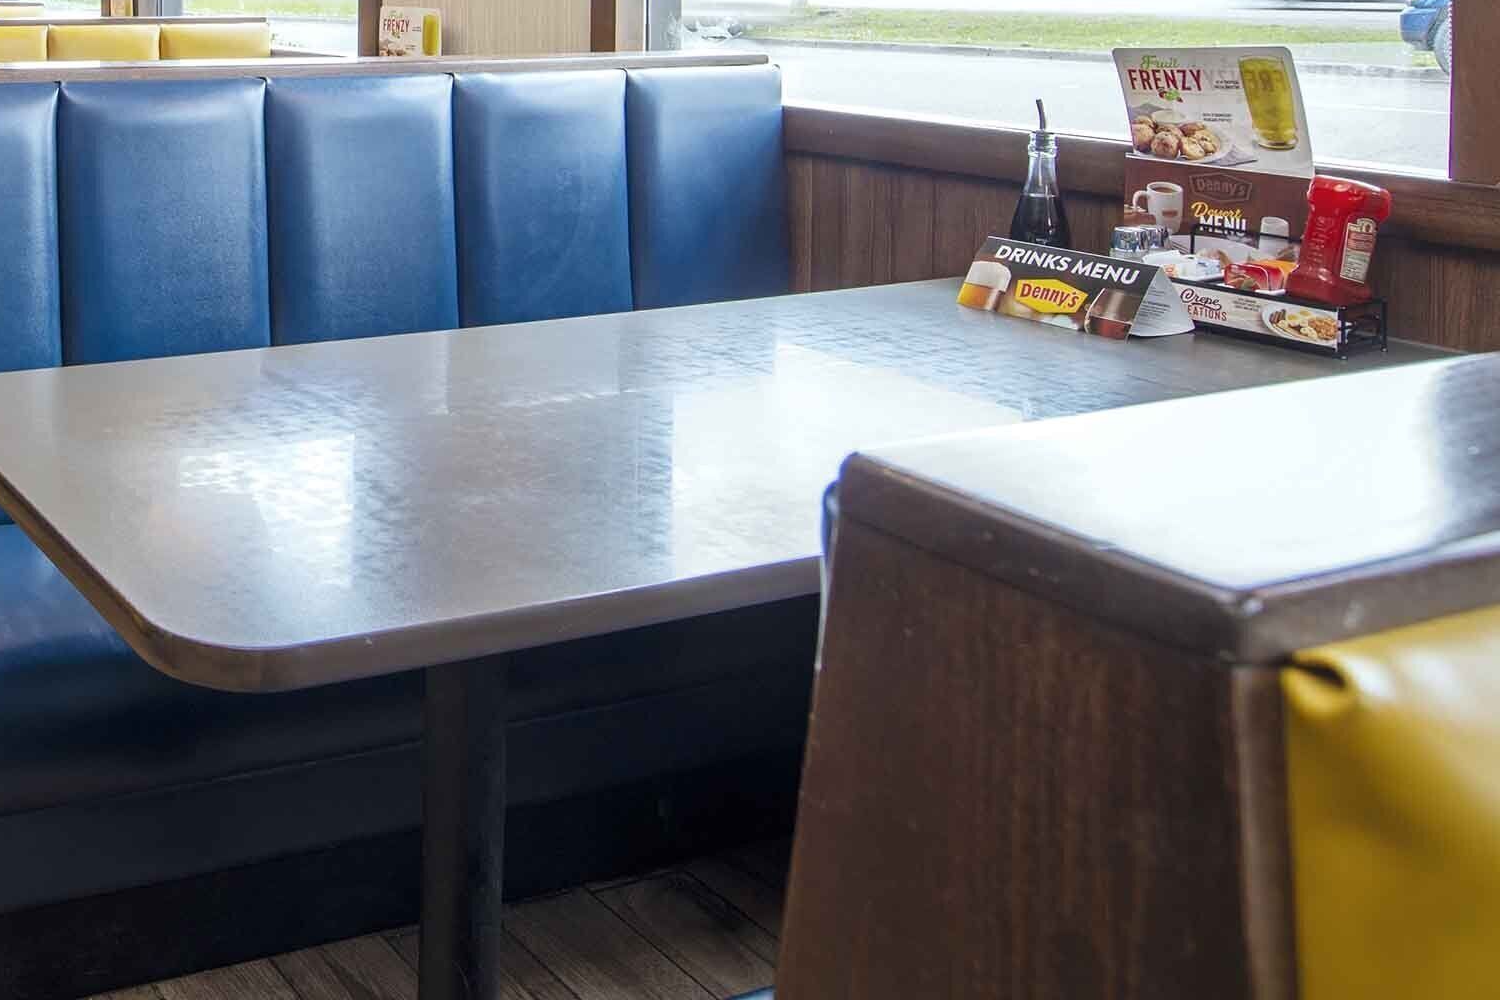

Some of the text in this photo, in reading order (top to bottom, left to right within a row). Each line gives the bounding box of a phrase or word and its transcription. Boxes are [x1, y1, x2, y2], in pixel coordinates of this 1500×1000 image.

[383, 18, 410, 32] FRENZY
[1127, 69, 1202, 92] FRENZY
[1200, 215, 1246, 237] MENU
[995, 245, 1140, 285] DRINKS MENU
[1020, 283, 1080, 309] Denny's
[1180, 288, 1221, 308] Crepe
[1187, 304, 1228, 321] EATIONS
